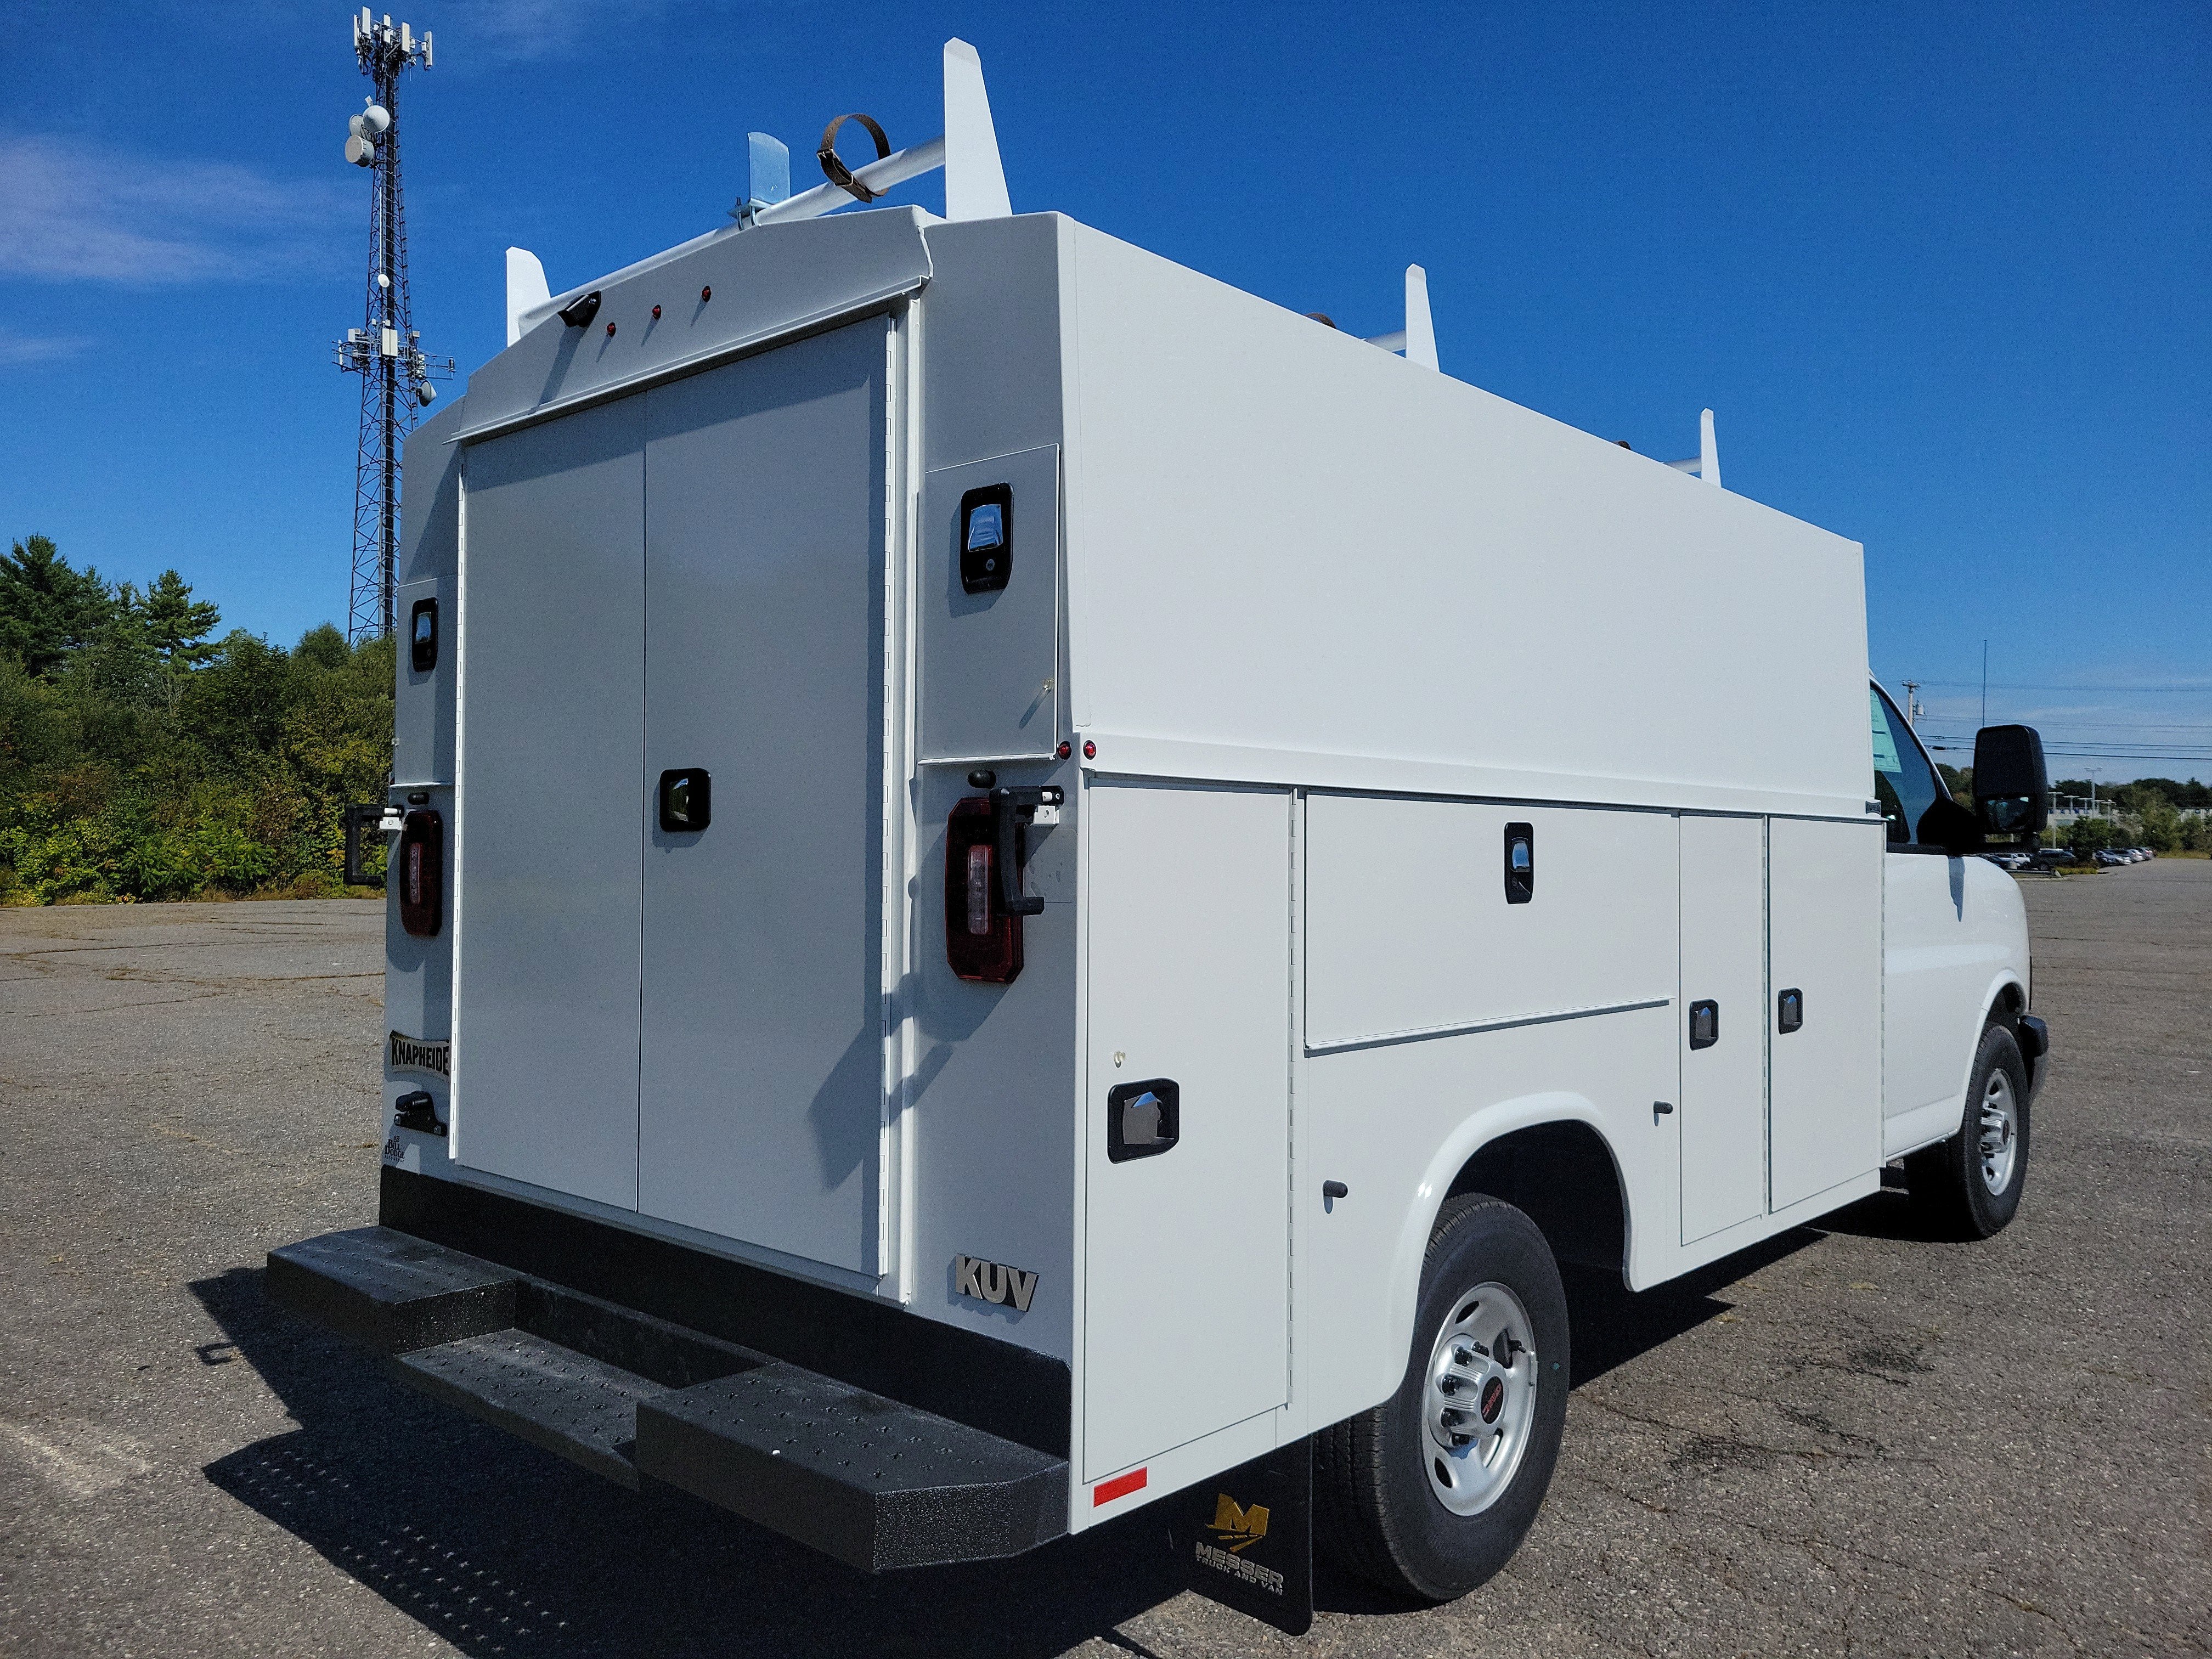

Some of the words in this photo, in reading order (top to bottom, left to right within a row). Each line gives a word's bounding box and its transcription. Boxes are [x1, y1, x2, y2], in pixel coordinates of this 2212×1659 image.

[392, 1037, 449, 1077] KNAPHEIDE
[385, 1145, 405, 1159] DODGE
[955, 1254, 1039, 1312] KUV
[1195, 1542, 1284, 1589] MESSER
[1195, 1554, 1231, 1573] TRUCK
[1234, 1570, 1257, 1584] AND
[1261, 1581, 1283, 1595] VAN
